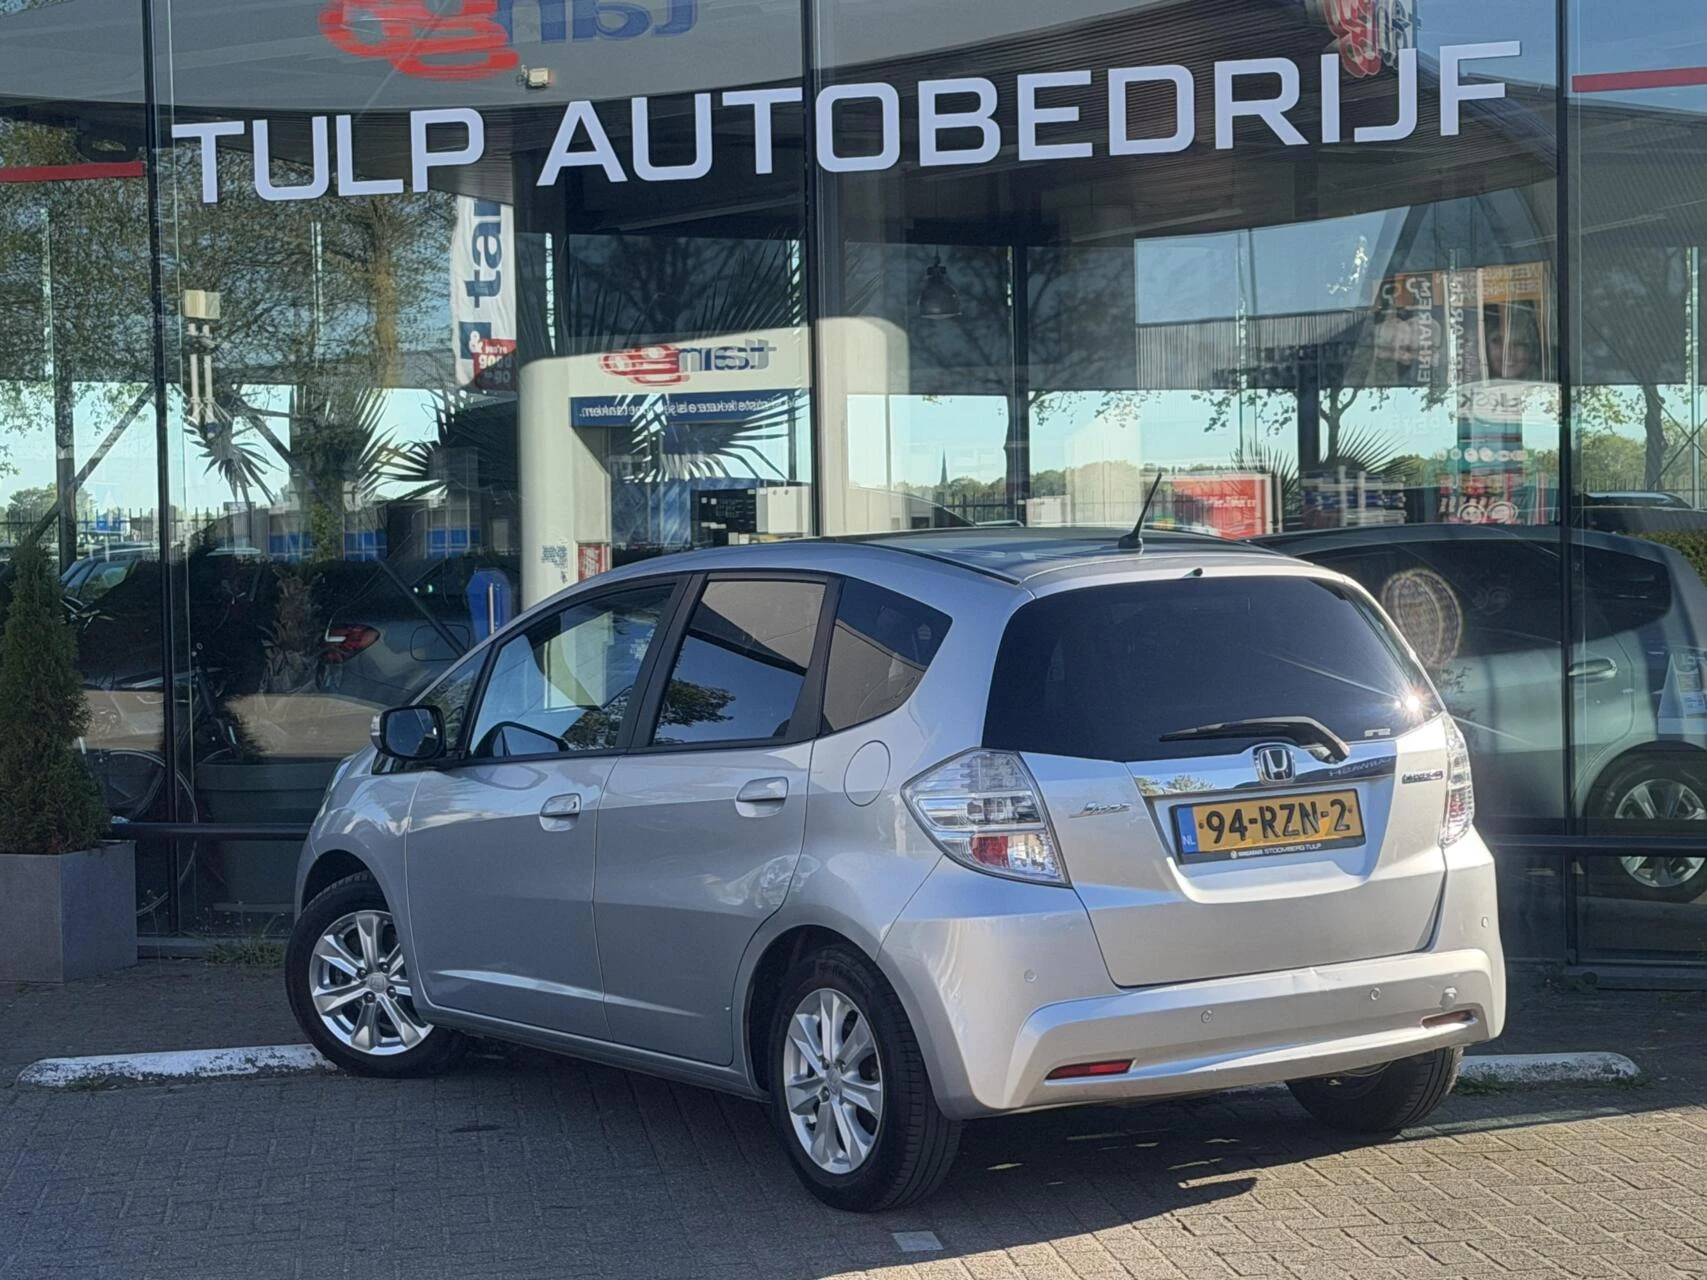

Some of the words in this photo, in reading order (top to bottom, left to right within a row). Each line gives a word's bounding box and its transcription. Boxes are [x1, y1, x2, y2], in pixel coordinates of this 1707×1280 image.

[171, 107, 485, 204] TULP
[537, 40, 1521, 188] AUTOBEDRIJF
[1182, 836, 1196, 846] NL
[1206, 798, 1351, 845] 94-RZN-2
